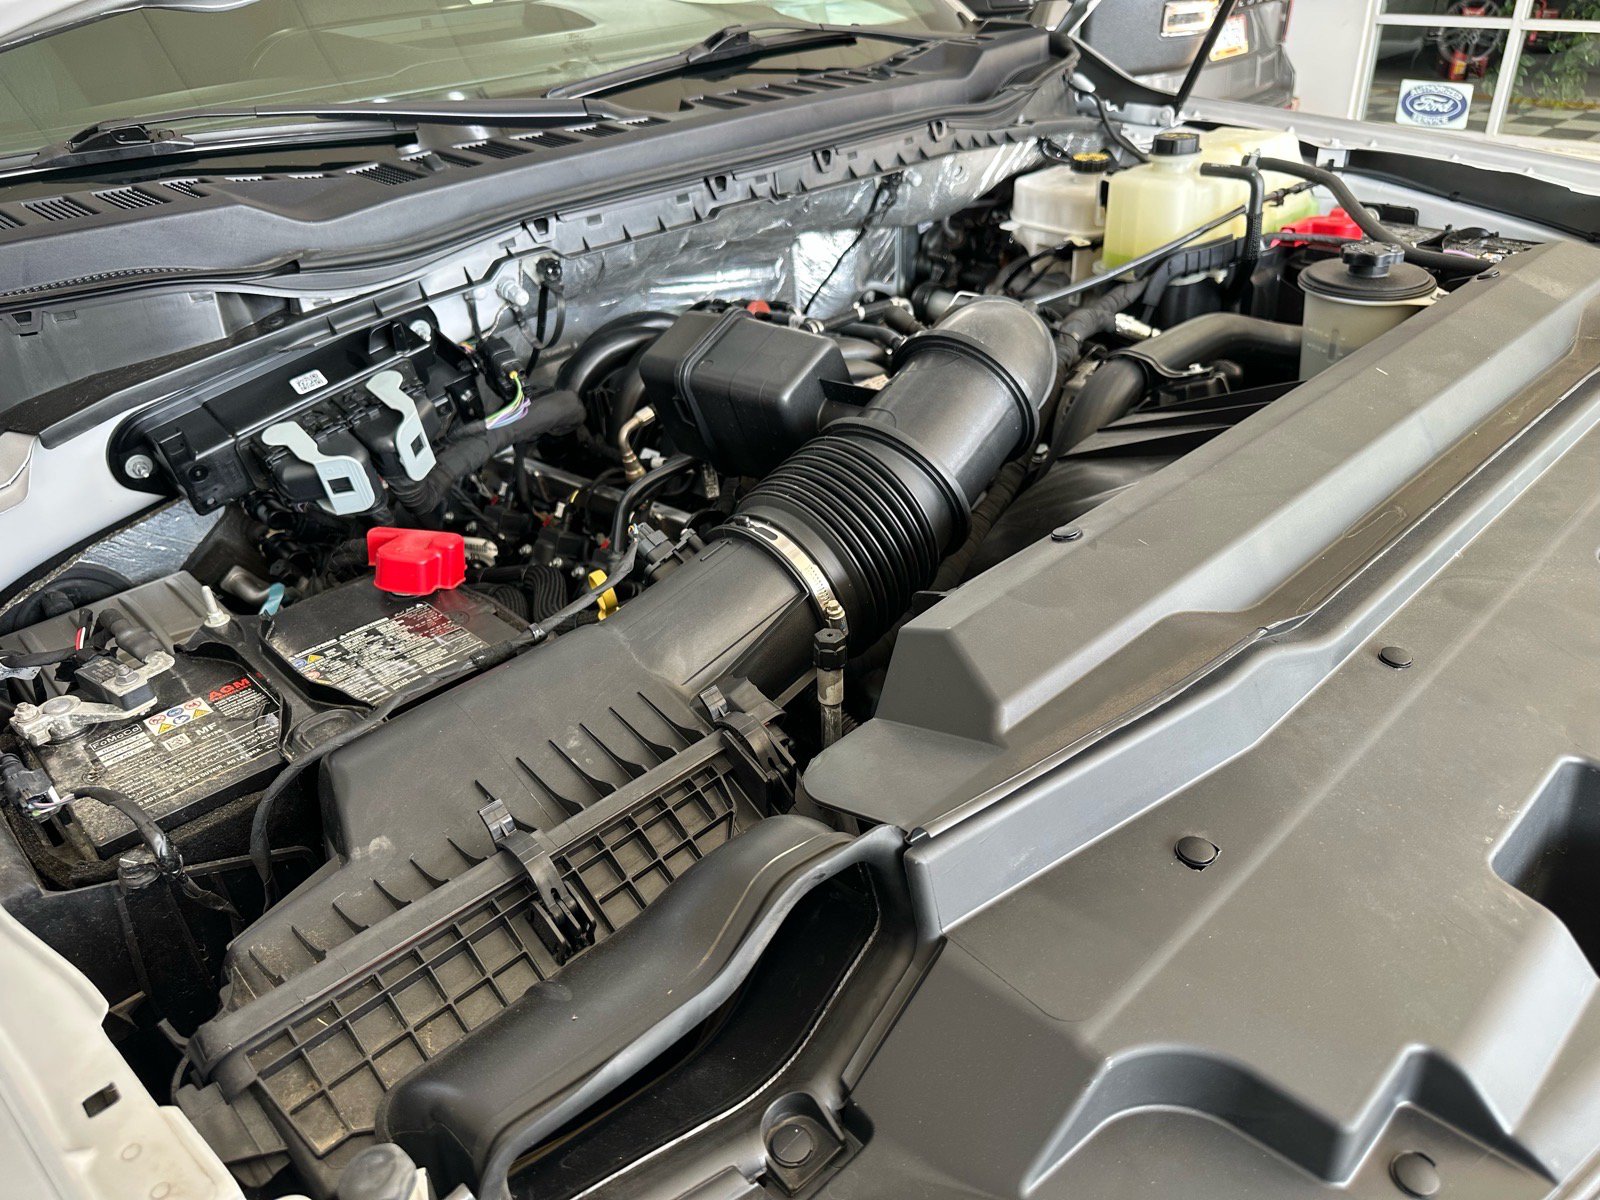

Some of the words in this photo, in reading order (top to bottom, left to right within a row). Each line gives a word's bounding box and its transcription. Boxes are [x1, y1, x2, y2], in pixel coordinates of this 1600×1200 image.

[1413, 95, 1455, 112] Ford
[208, 678, 250, 700] AGM
[92, 727, 139, 749] FoMoCo
[195, 722, 217, 736] MF
